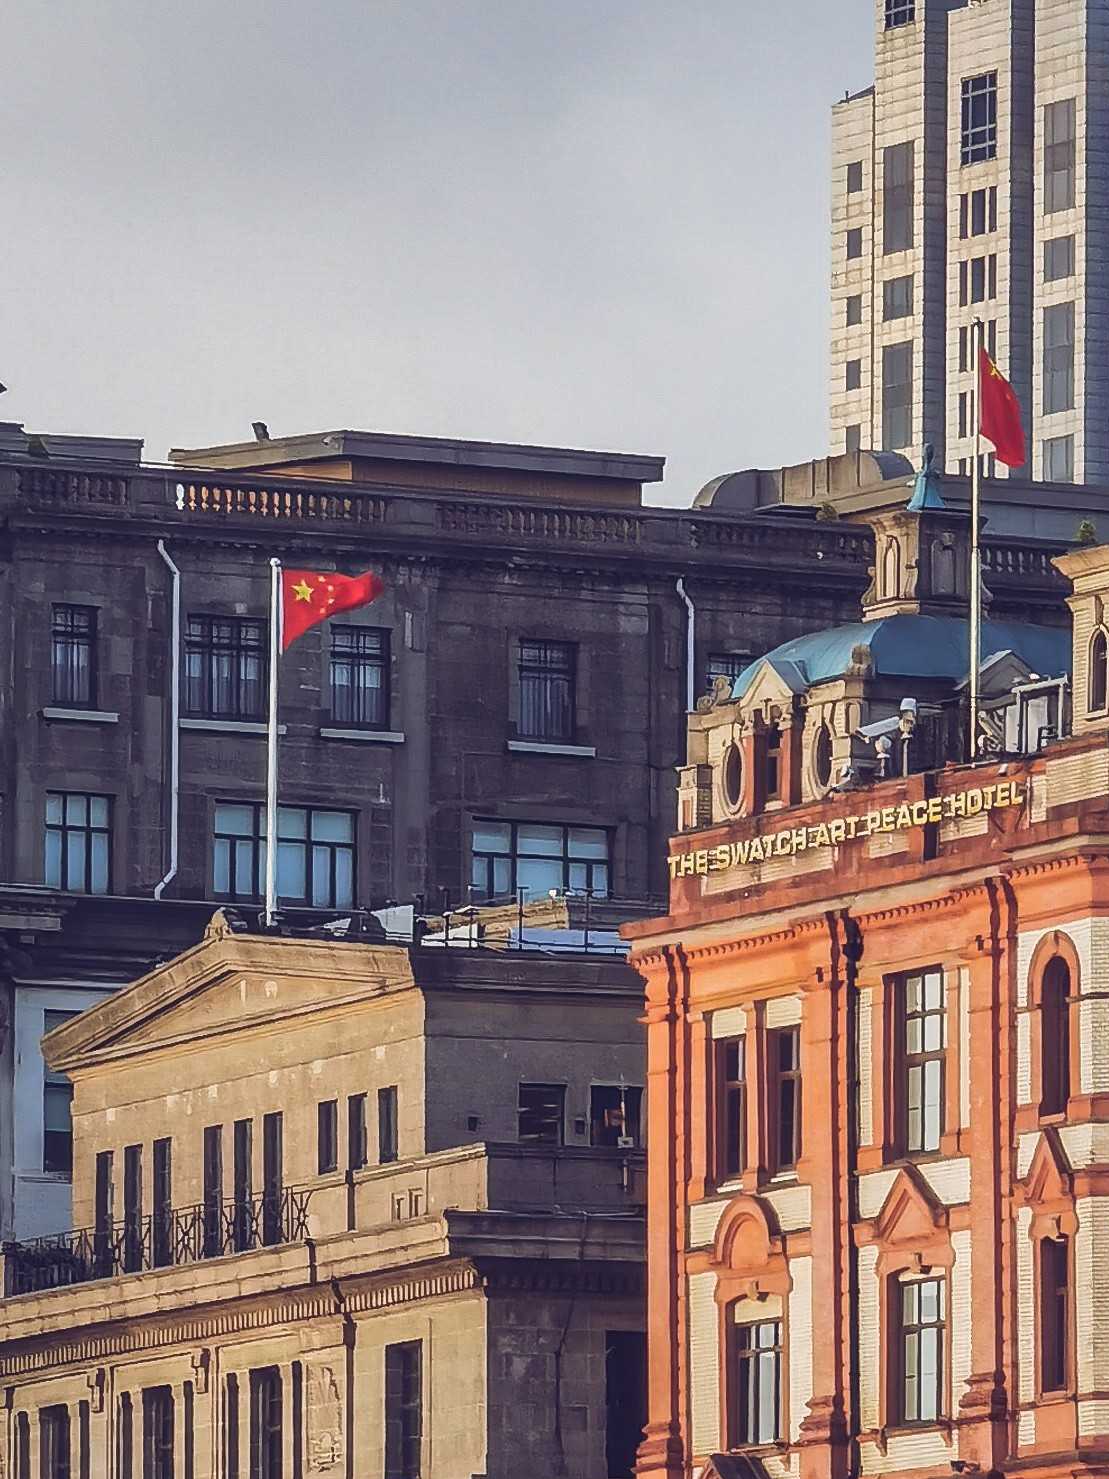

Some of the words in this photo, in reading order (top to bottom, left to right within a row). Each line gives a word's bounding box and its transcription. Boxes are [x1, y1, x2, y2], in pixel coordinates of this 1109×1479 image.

[667, 853, 709, 879] THE
[716, 826, 808, 870] SWATCH
[814, 816, 860, 847] ART
[867, 797, 942, 836] PEACE
[948, 781, 1024, 819] HOTEL
